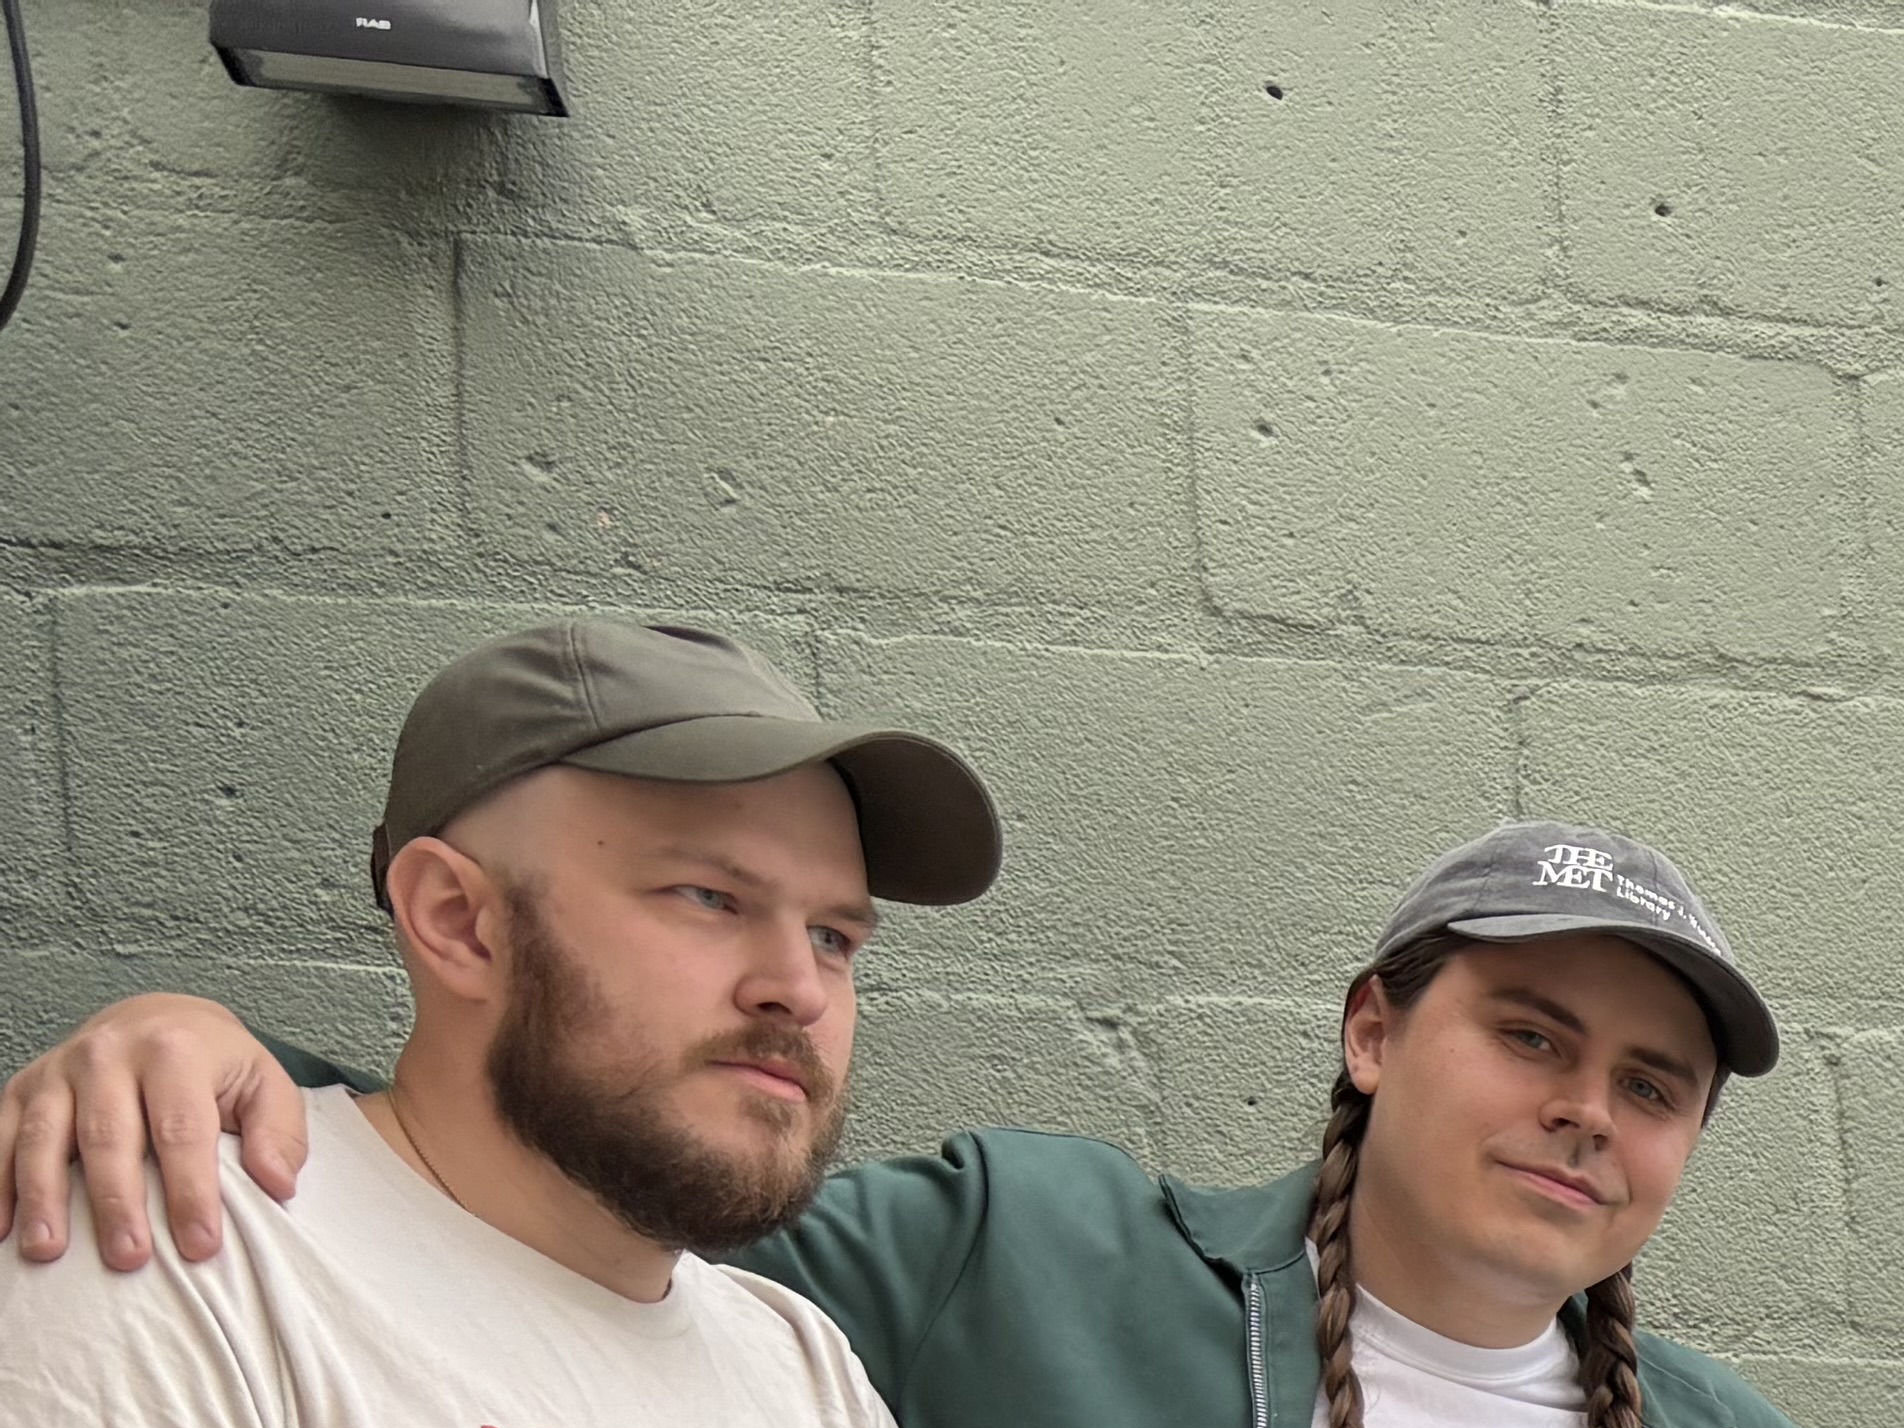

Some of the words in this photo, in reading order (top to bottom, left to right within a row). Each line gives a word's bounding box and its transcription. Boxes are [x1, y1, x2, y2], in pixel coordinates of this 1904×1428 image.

[1544, 843, 1614, 872] THE
[1532, 860, 1614, 893] MET
[1616, 873, 1676, 911] Thomas
[1616, 886, 1671, 921] Library
